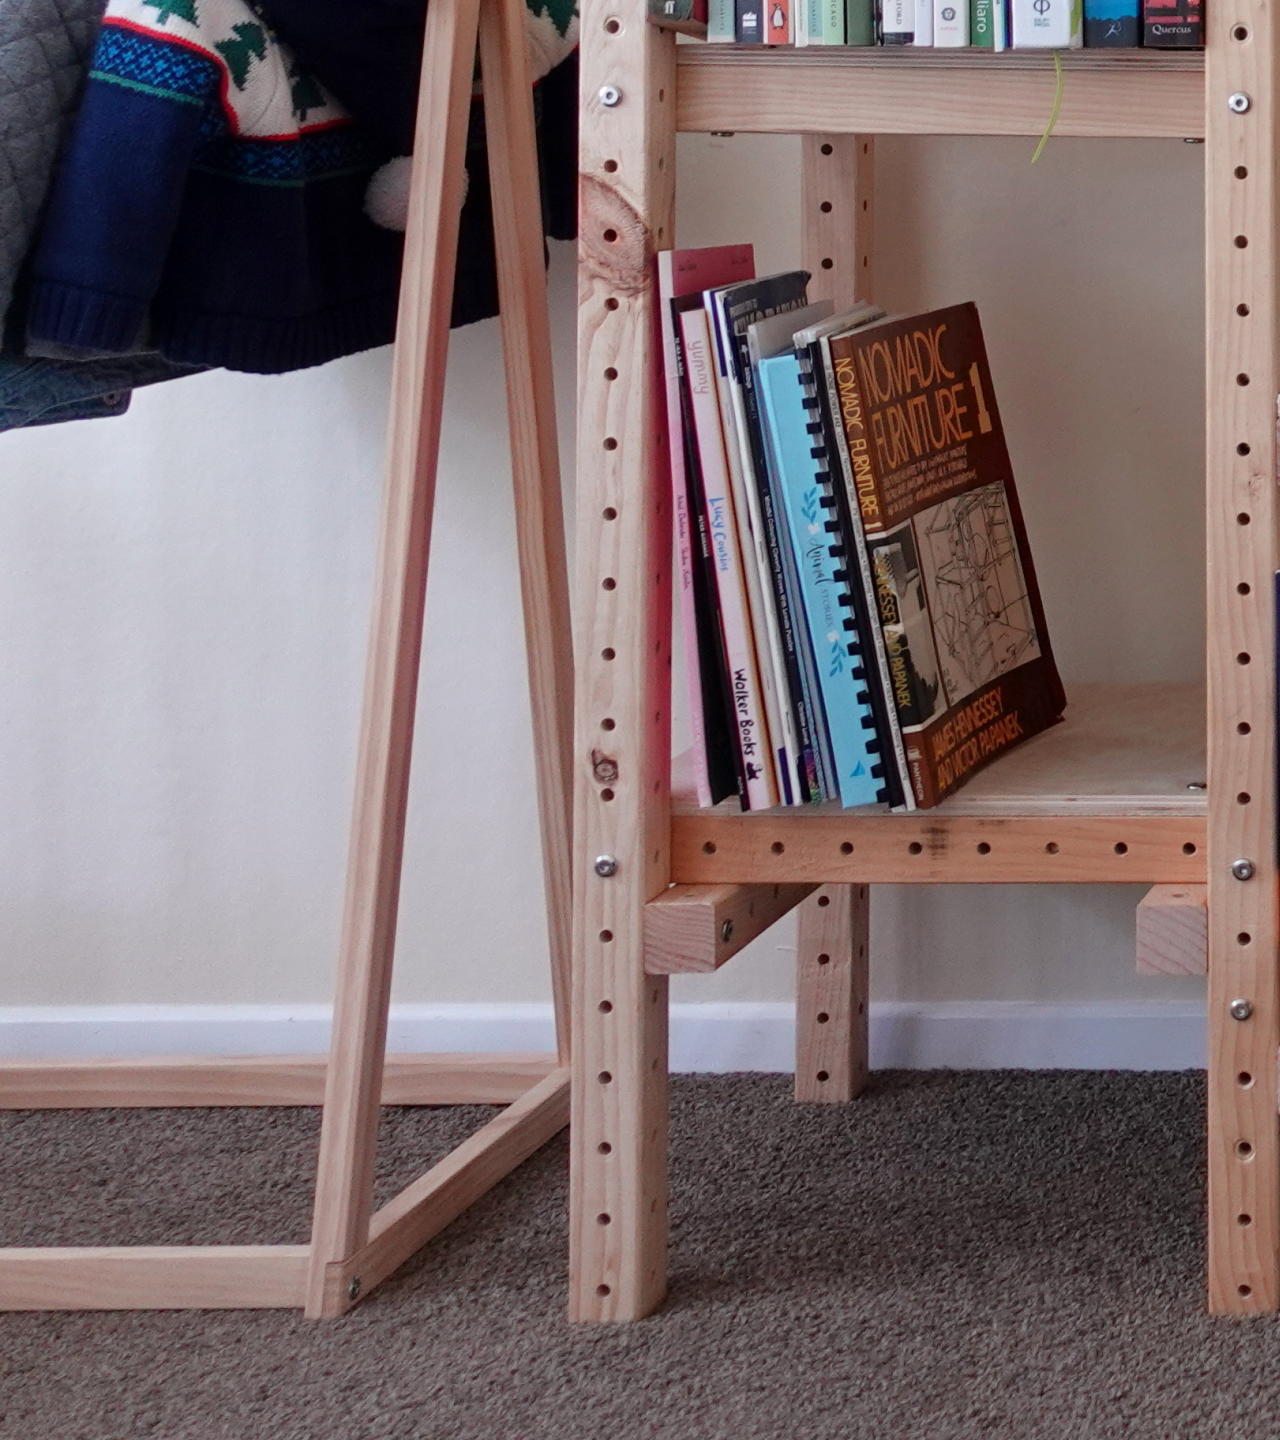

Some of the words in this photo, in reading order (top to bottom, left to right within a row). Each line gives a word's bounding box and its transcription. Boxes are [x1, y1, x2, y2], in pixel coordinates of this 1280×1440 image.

[1152, 24, 1192, 35] Quercus
[858, 324, 955, 407] NOMADIC
[872, 383, 973, 474] FURNITURE
[969, 362, 992, 434] 1
[734, 669, 748, 716] Walker
[740, 721, 755, 757] Books
